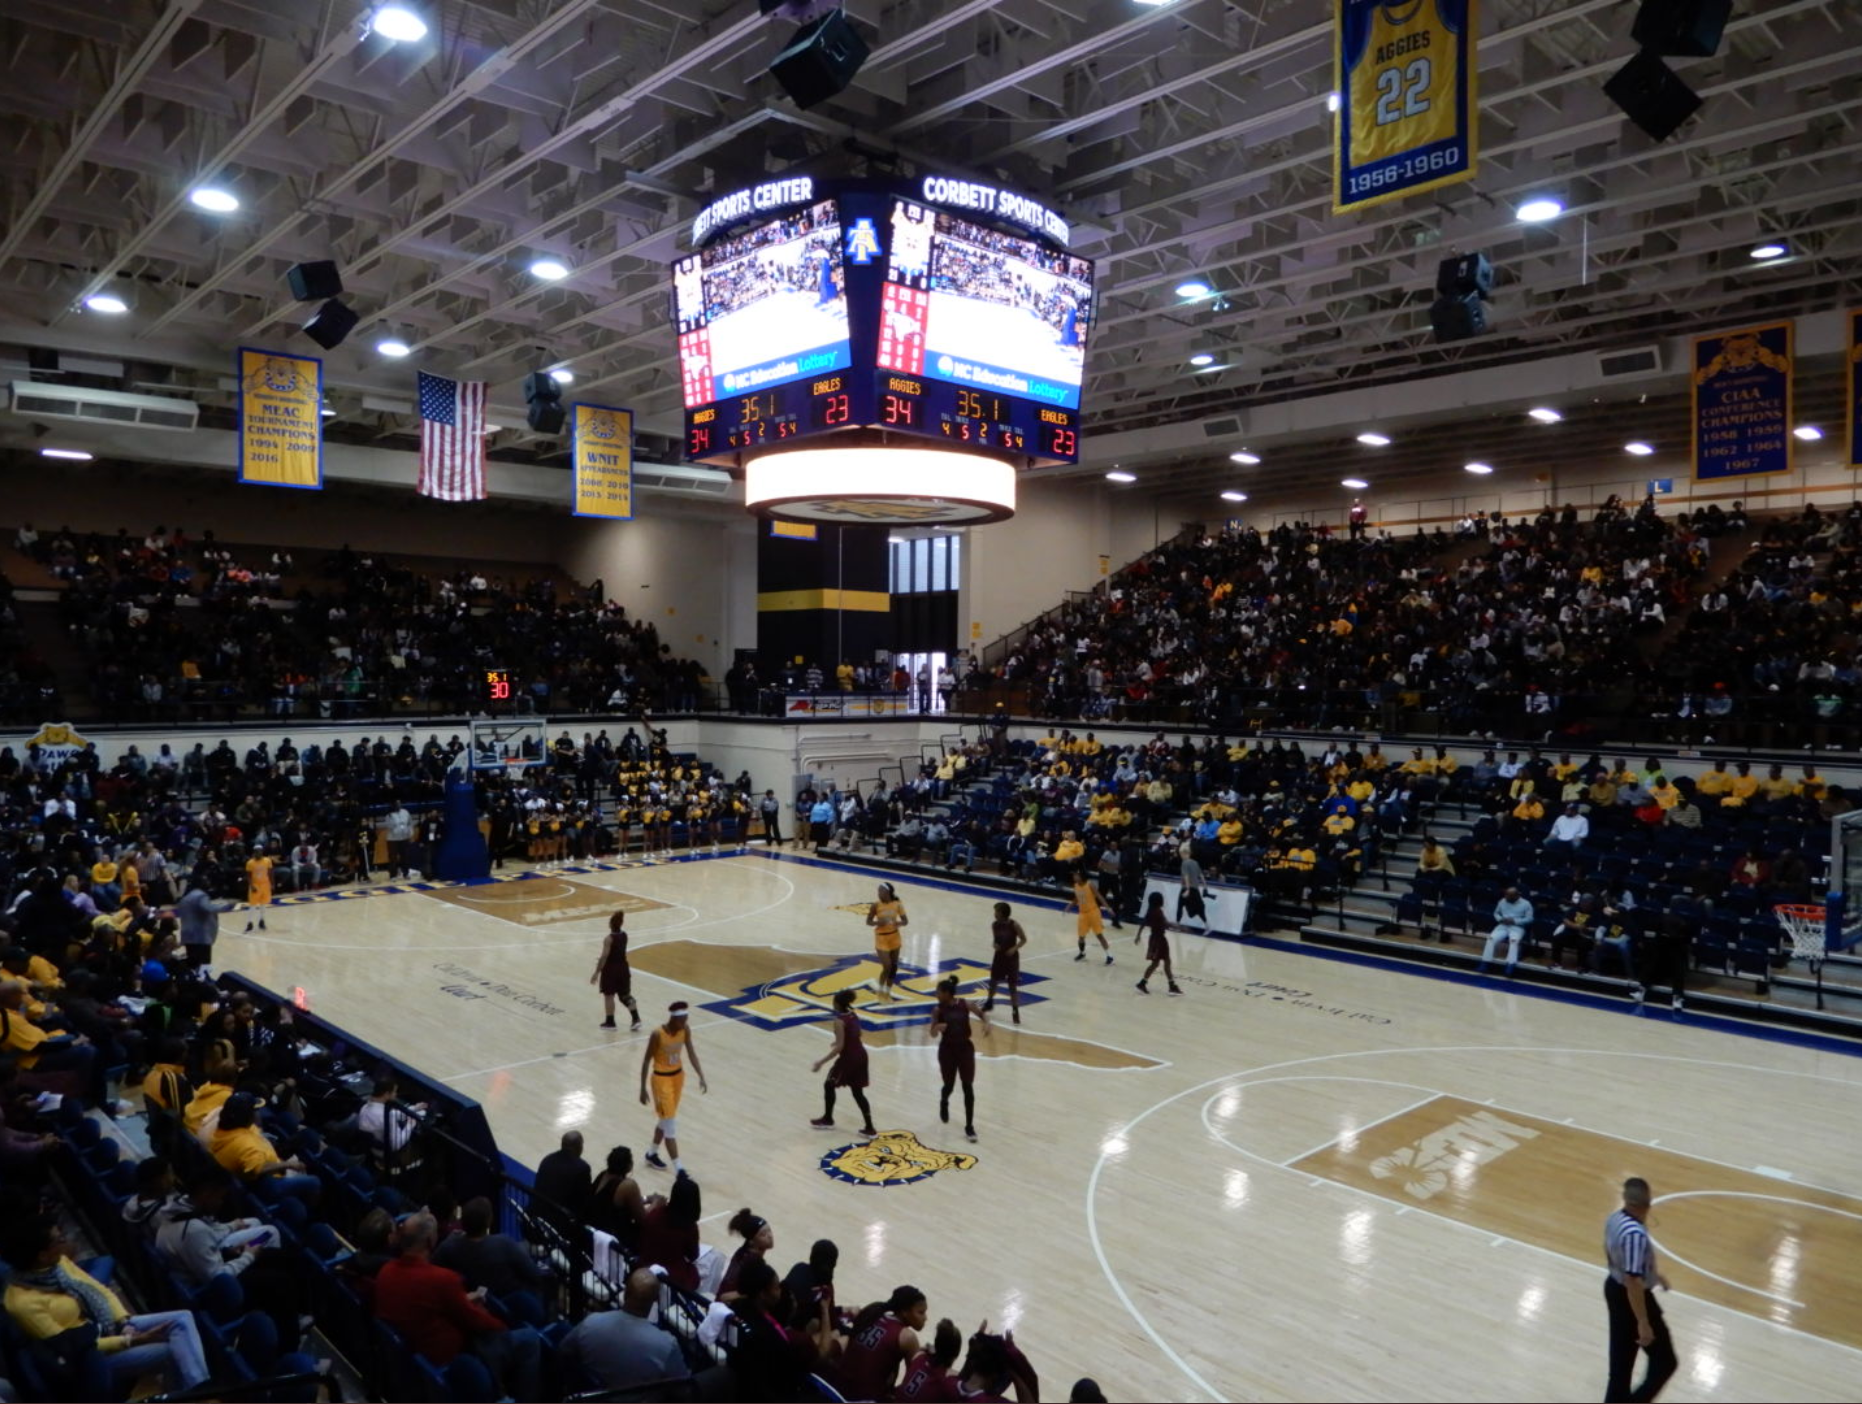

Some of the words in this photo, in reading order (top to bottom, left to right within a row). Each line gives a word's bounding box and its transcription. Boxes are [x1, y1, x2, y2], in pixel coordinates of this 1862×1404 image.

[1376, 30, 1431, 65] AGGIES
[1376, 56, 1431, 127] 22
[1349, 147, 1459, 194] 1956-1960
[711, 189, 750, 224] SPORTS
[753, 177, 813, 209] CENTER
[923, 176, 997, 211] CORBETT
[999, 190, 1043, 227] SPORTS
[1044, 209, 1070, 247] CENTER
[799, 352, 837, 372] Lottery
[813, 377, 841, 396] EAGLES
[889, 377, 922, 396] AGGIES
[953, 362, 972, 379] NC
[973, 366, 1028, 392] Education
[1029, 381, 1068, 402] Lottery
[1721, 387, 1762, 404] CIAA
[262, 404, 300, 418] MEAC
[826, 394, 849, 424] 23
[886, 396, 911, 424] 34
[1040, 409, 1069, 426] EAGLES
[1701, 400, 1781, 418] CONFERENCE
[248, 415, 314, 430] TOURNAMENT
[1701, 410, 1783, 428] CHAMPIONS
[247, 425, 315, 441] CHAMPIONS
[758, 422, 765, 436] 2
[779, 422, 786, 438] 5
[789, 422, 797, 434] 4
[941, 422, 950, 435] 4
[961, 425, 970, 440] 5
[980, 422, 988, 437] 2
[691, 428, 709, 453] 34
[729, 435, 736, 447] 4
[743, 430, 751, 446] 5
[1004, 433, 1012, 447] 5
[1015, 436, 1023, 448] 4
[1053, 429, 1075, 456] 23
[587, 452, 620, 466] WNIT
[1703, 445, 1738, 458] 1962
[1724, 457, 1761, 470] 1967
[490, 682, 508, 699] 30
[905, 1370, 928, 1398] 5
